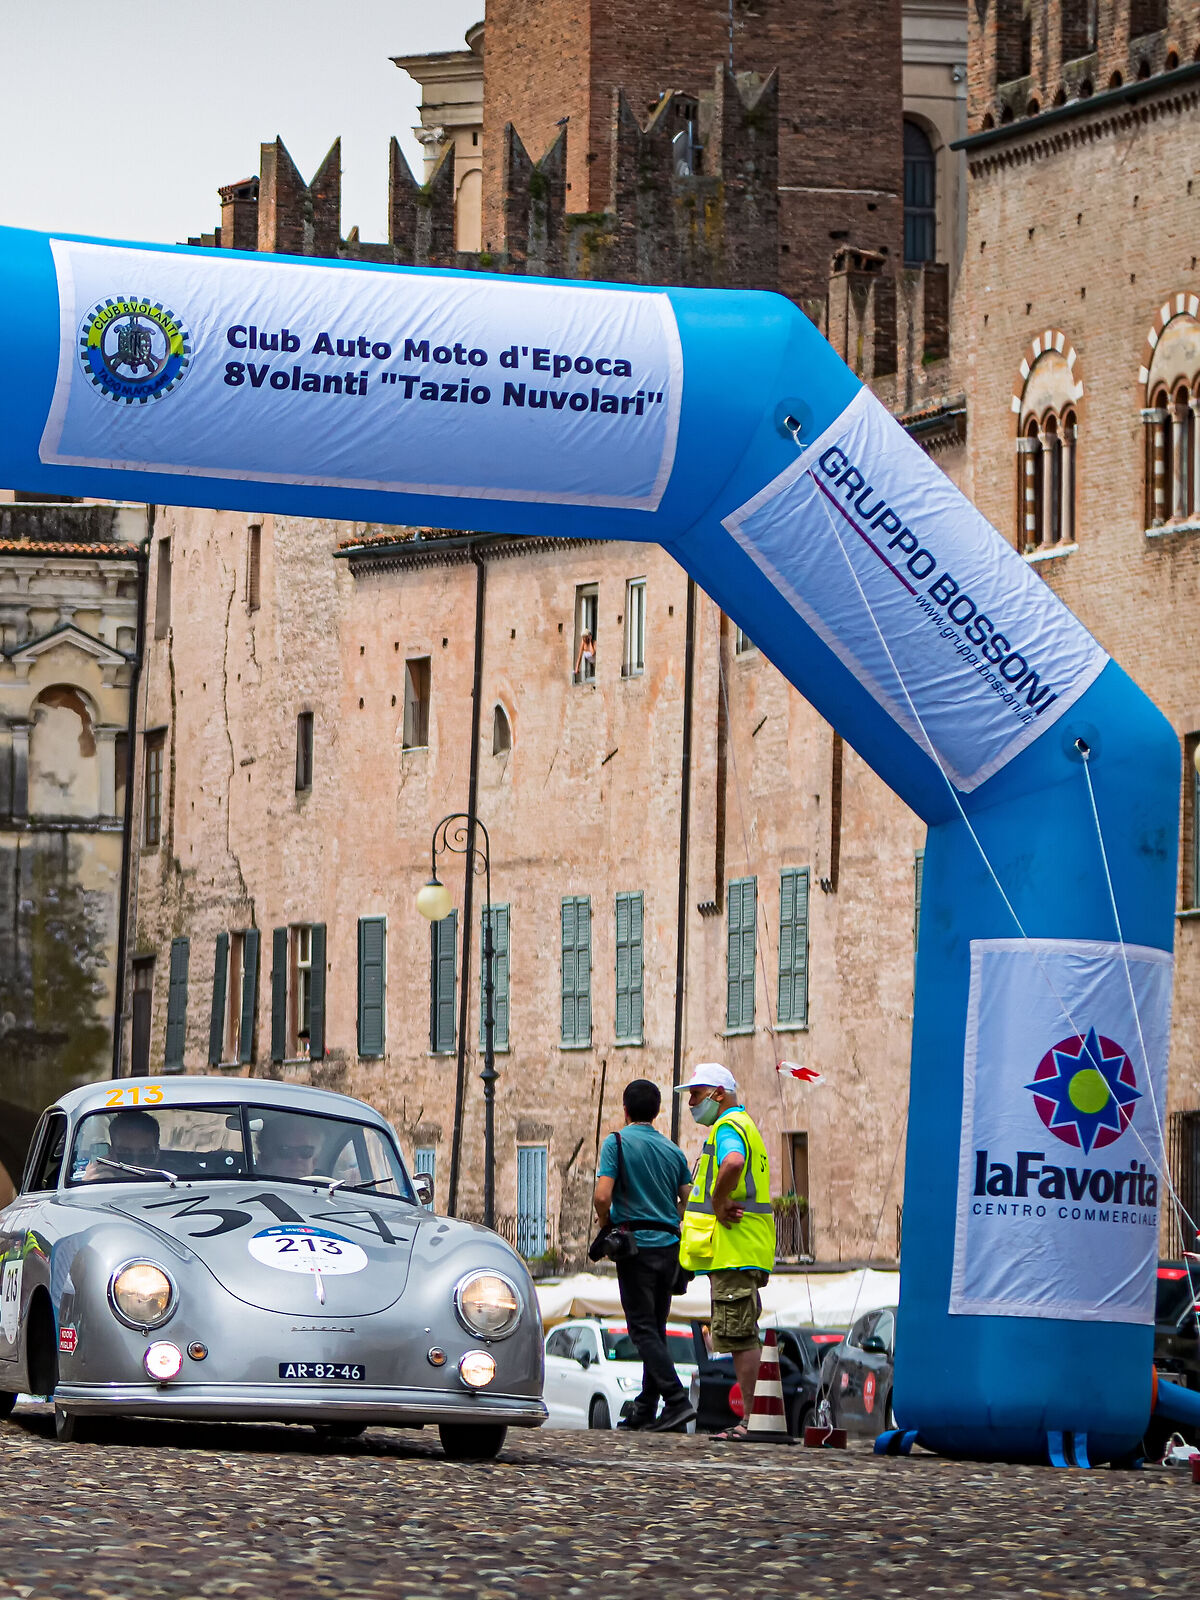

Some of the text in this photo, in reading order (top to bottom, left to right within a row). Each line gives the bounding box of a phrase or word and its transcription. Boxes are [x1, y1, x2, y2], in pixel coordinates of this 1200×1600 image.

[94, 306, 121, 331] CLUB
[226, 324, 633, 380] Club Auto Moto d'Epoca
[223, 361, 665, 417] 8Volanti "Tazio Nuvolari"
[819, 446, 1058, 716] GRUPPO BOSSONI
[916, 594, 1036, 725] www.gruppobossoni.it
[105, 1085, 164, 1106] 213
[973, 1150, 1158, 1208] laFavorita
[143, 1190, 409, 1246] 314
[973, 1203, 1157, 1227] CENTRO COMMERCIALE
[275, 1238, 343, 1255] 213
[5, 1267, 19, 1302] 213
[284, 1363, 361, 1380] AR-82-46
